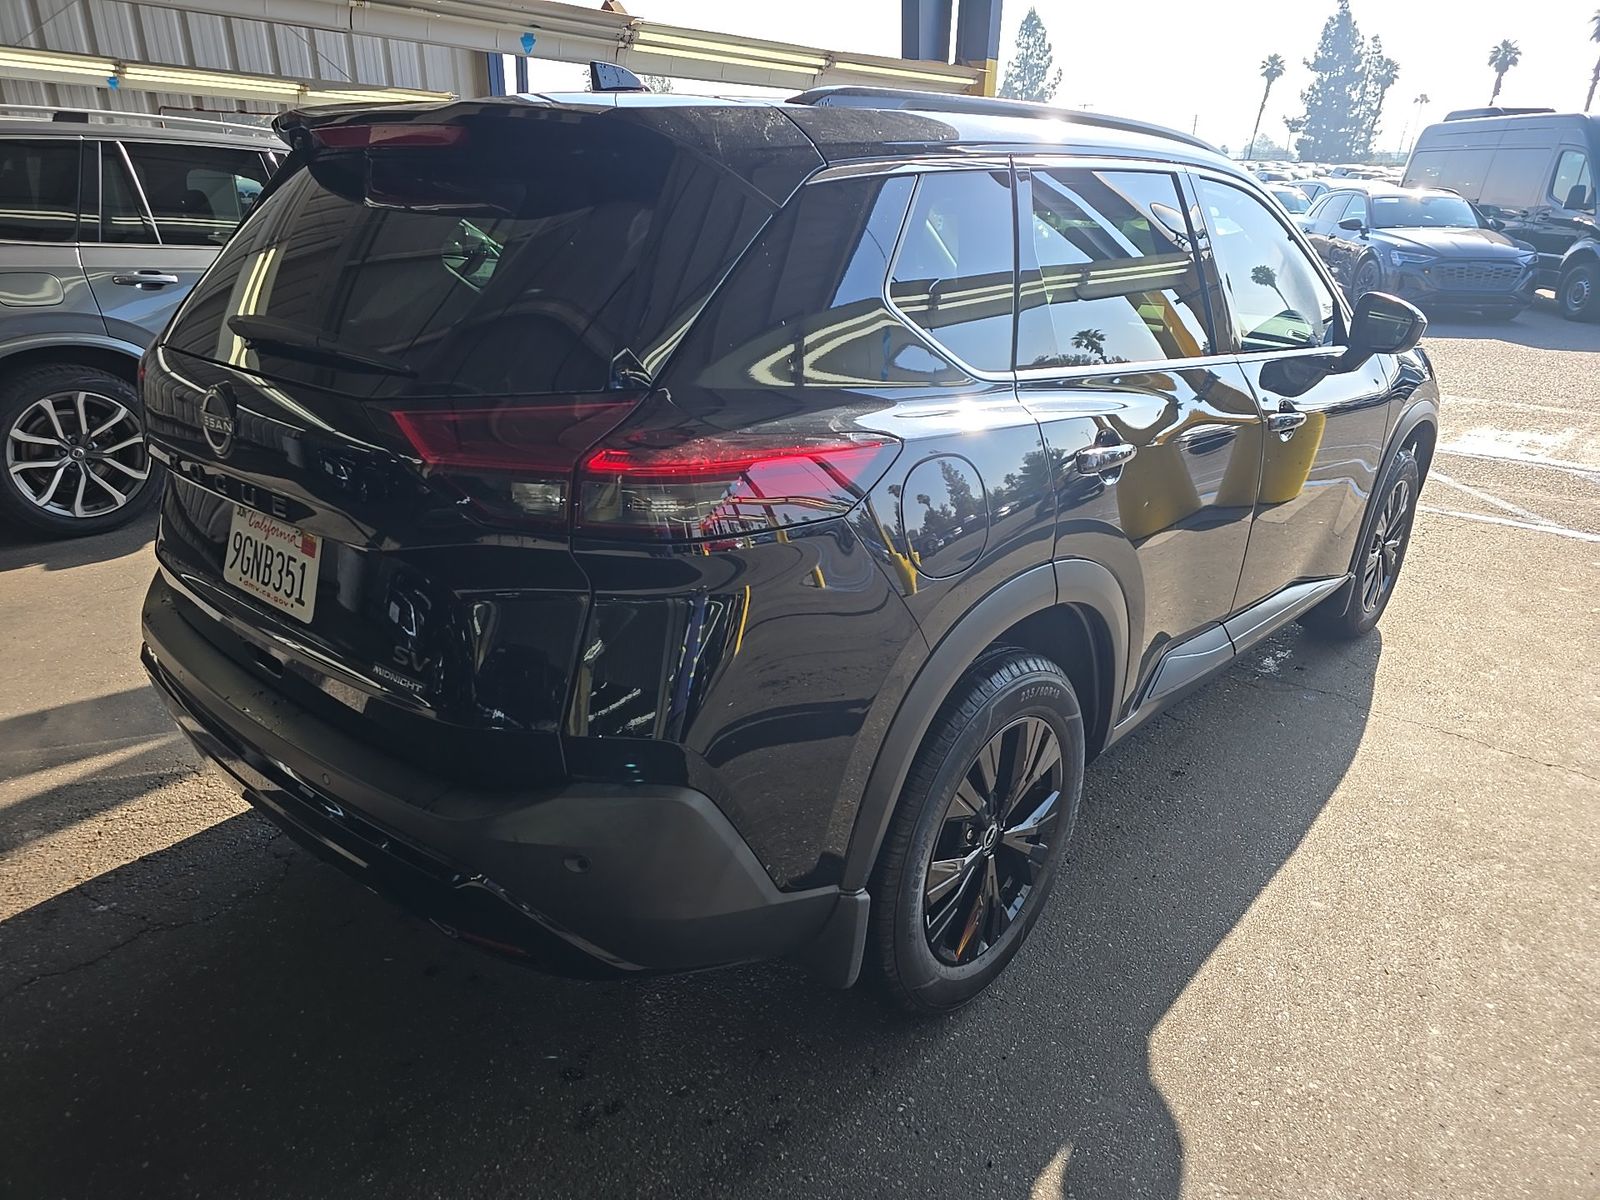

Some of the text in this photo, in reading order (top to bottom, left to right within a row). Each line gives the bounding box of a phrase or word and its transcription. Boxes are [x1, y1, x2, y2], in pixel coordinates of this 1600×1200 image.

[248, 508, 302, 548] California
[229, 531, 306, 607] 9GNB351
[243, 580, 289, 607] dmv.ca.gov
[392, 645, 430, 672] SV
[372, 664, 423, 692] MIDNIGHT
